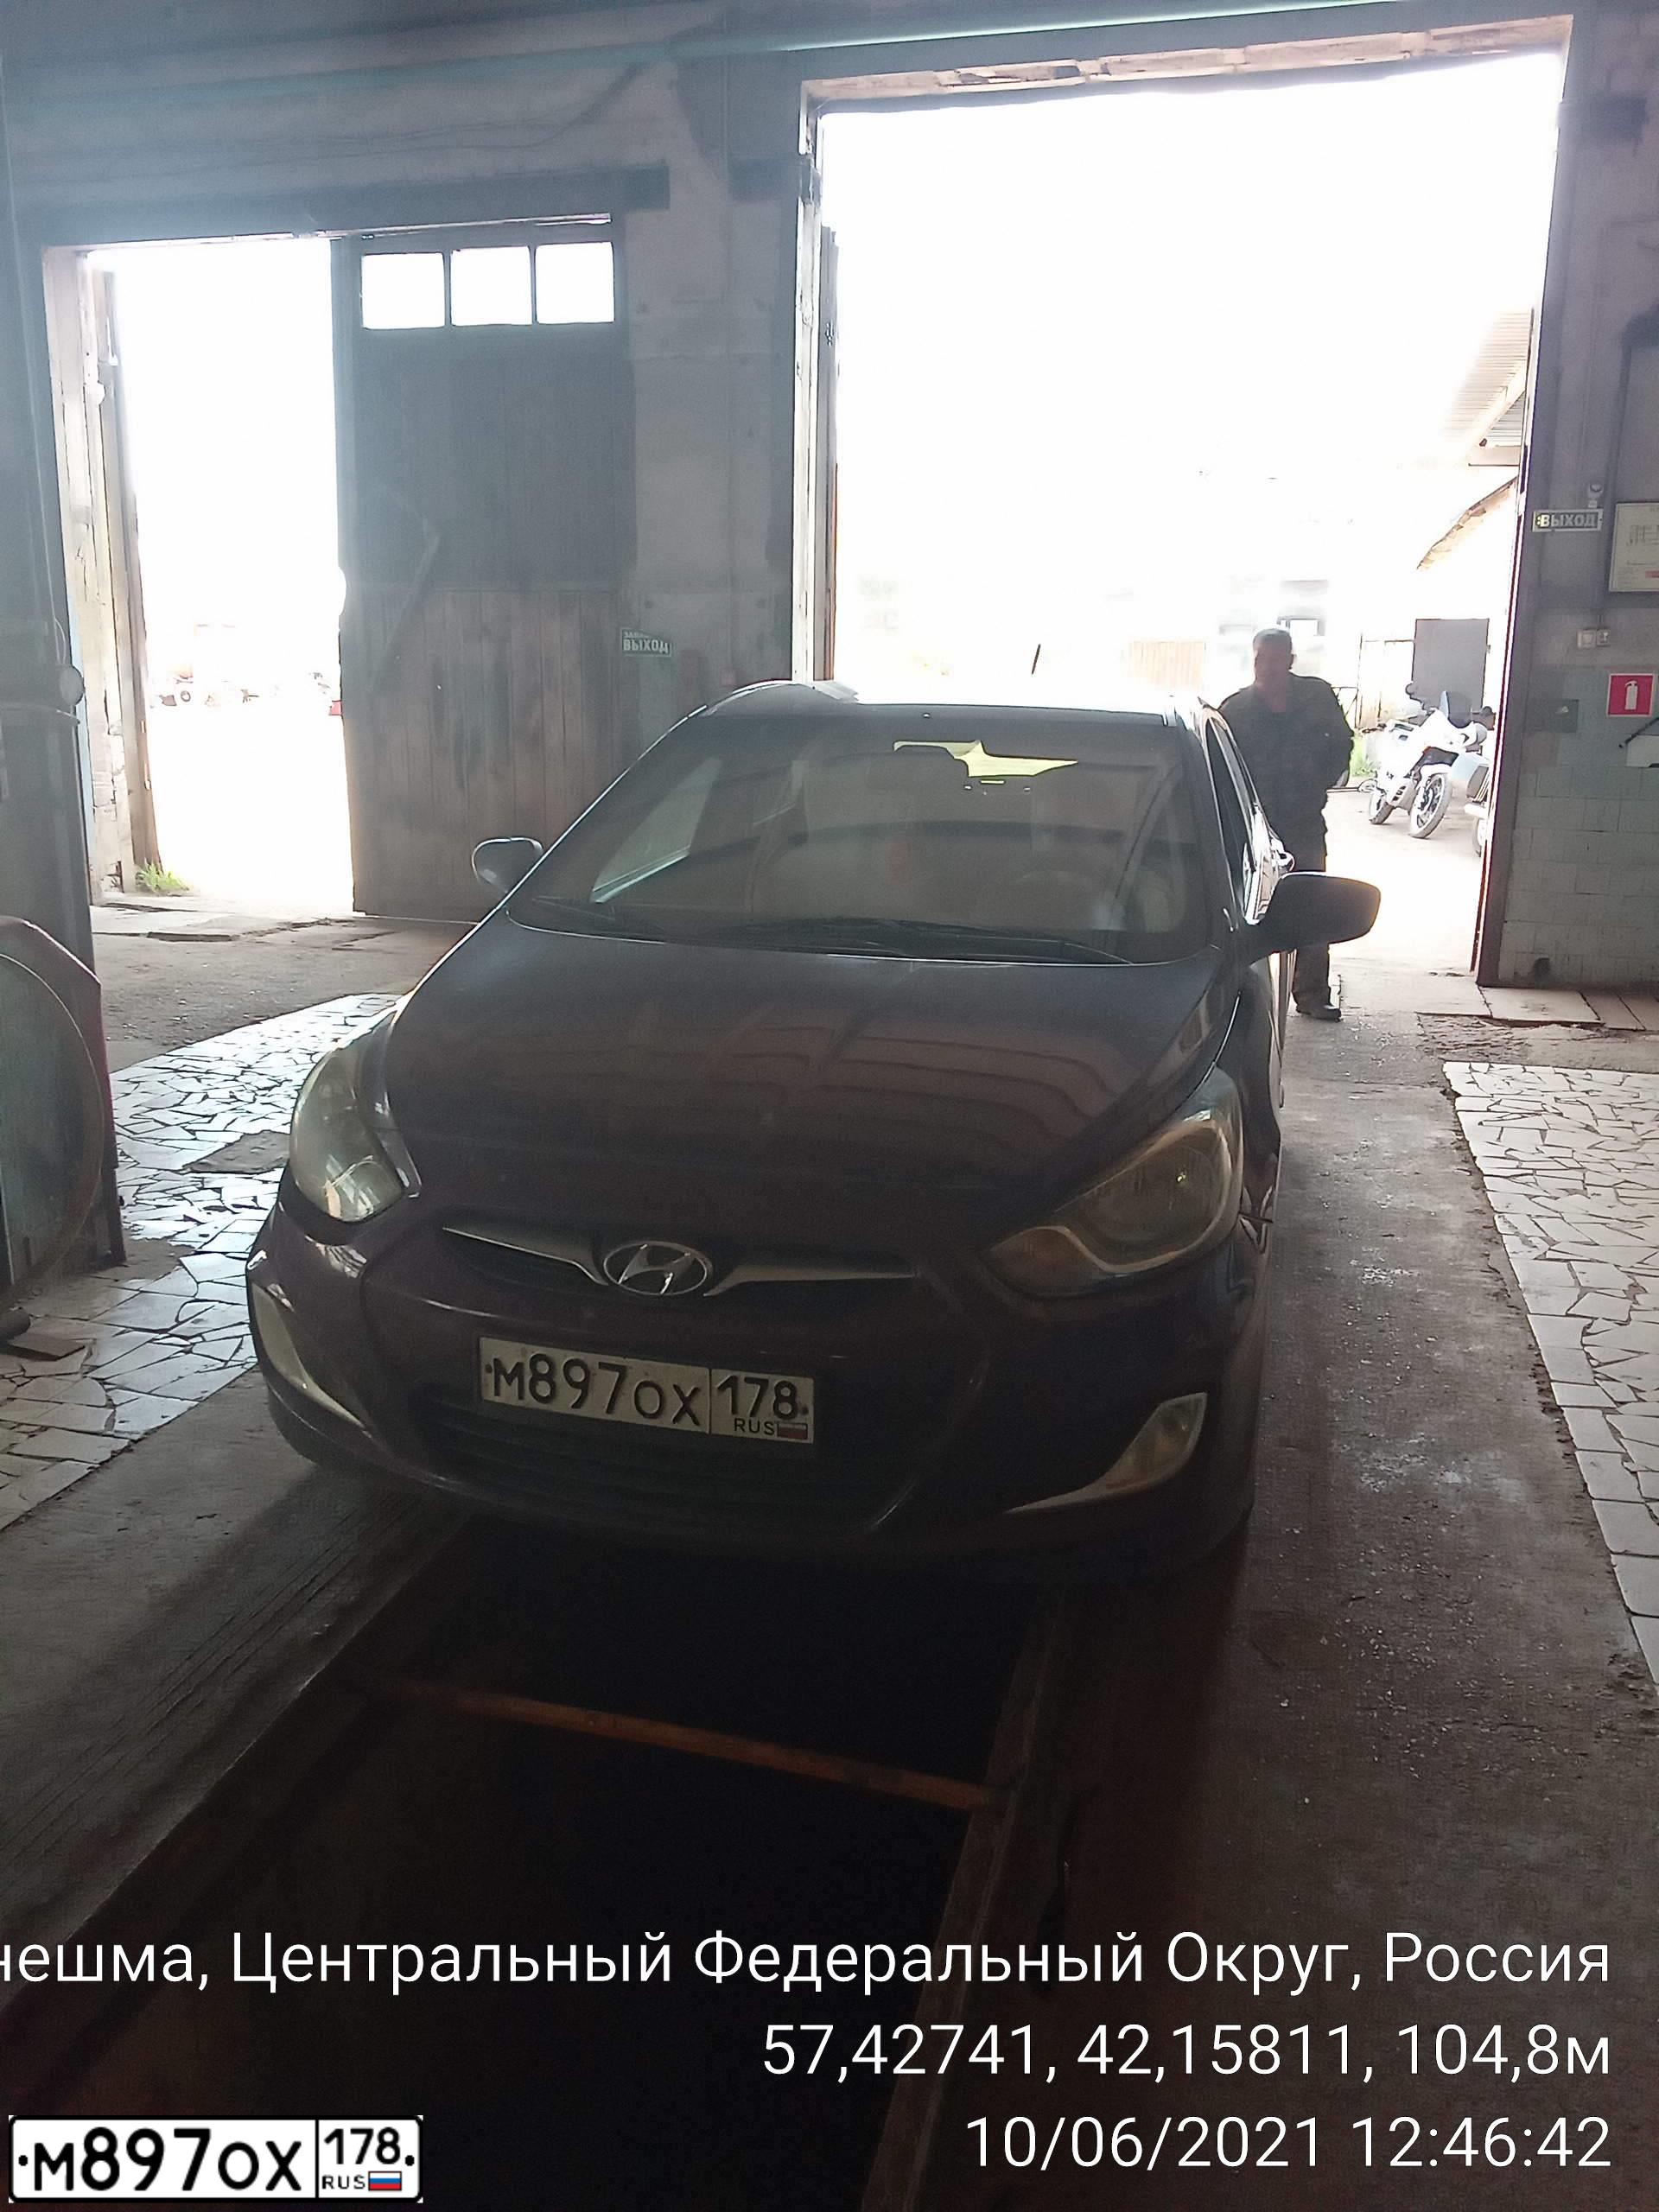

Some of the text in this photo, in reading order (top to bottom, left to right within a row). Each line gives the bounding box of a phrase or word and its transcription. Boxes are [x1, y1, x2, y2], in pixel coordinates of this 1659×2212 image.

[1540, 514, 1596, 527] ВЫХОД
[623, 639, 669, 653] ВЫХОД
[715, 1375, 798, 1421] 178
[734, 1418, 776, 1436] RUS
